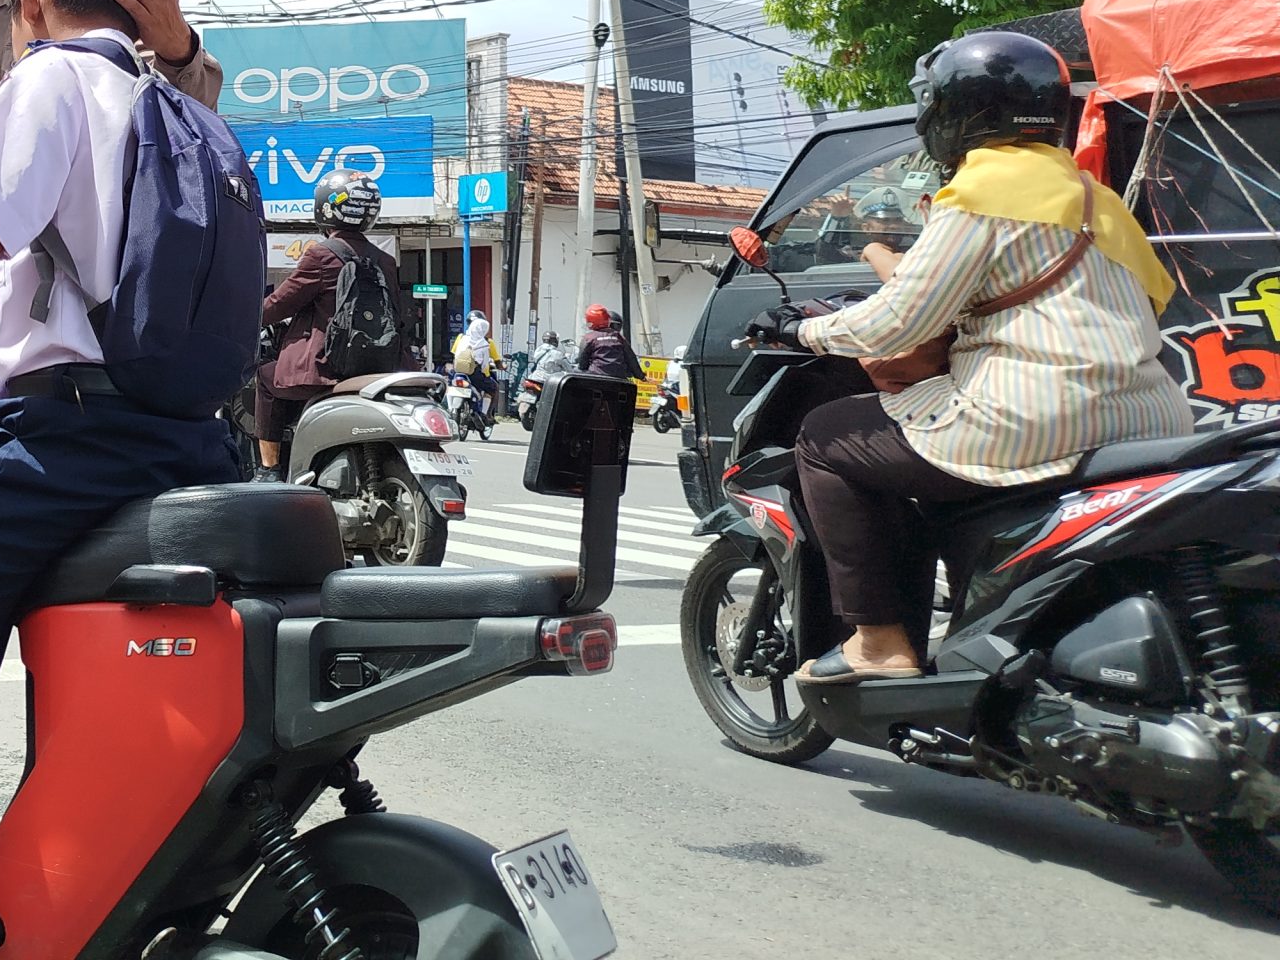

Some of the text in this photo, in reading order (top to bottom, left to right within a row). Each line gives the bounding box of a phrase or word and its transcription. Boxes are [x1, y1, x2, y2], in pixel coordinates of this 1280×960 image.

[1012, 116, 1056, 124] HONDA
[126, 638, 197, 657] M60
[505, 864, 536, 911] B
